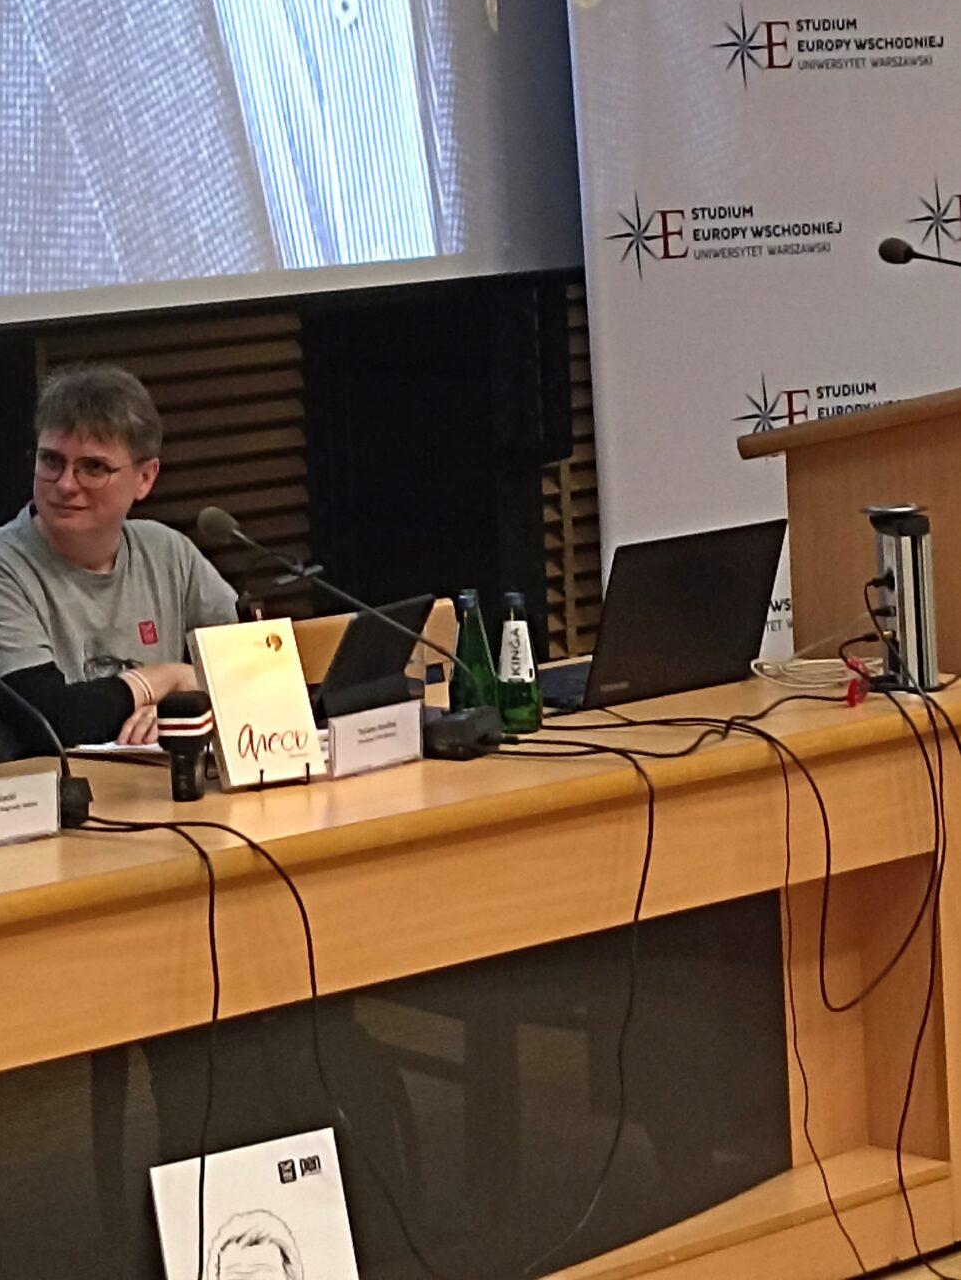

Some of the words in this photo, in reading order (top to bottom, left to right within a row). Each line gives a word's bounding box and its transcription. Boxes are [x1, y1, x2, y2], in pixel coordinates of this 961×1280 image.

[796, 18, 858, 33] STUDIUM
[797, 38, 851, 53] EUROPY
[853, 35, 944, 51] WSCHODNIEJ
[798, 57, 867, 71] UNIWERSYTET
[869, 55, 933, 69] WARSZAWSKI
[691, 205, 754, 221] STUDIUM
[692, 226, 748, 242] EUROPY
[750, 221, 843, 239] WSCHODNIEJ
[693, 245, 764, 261] UNIWERSYTET
[766, 242, 832, 257] WARSZAWSKI
[816, 382, 877, 400] STUDIUM
